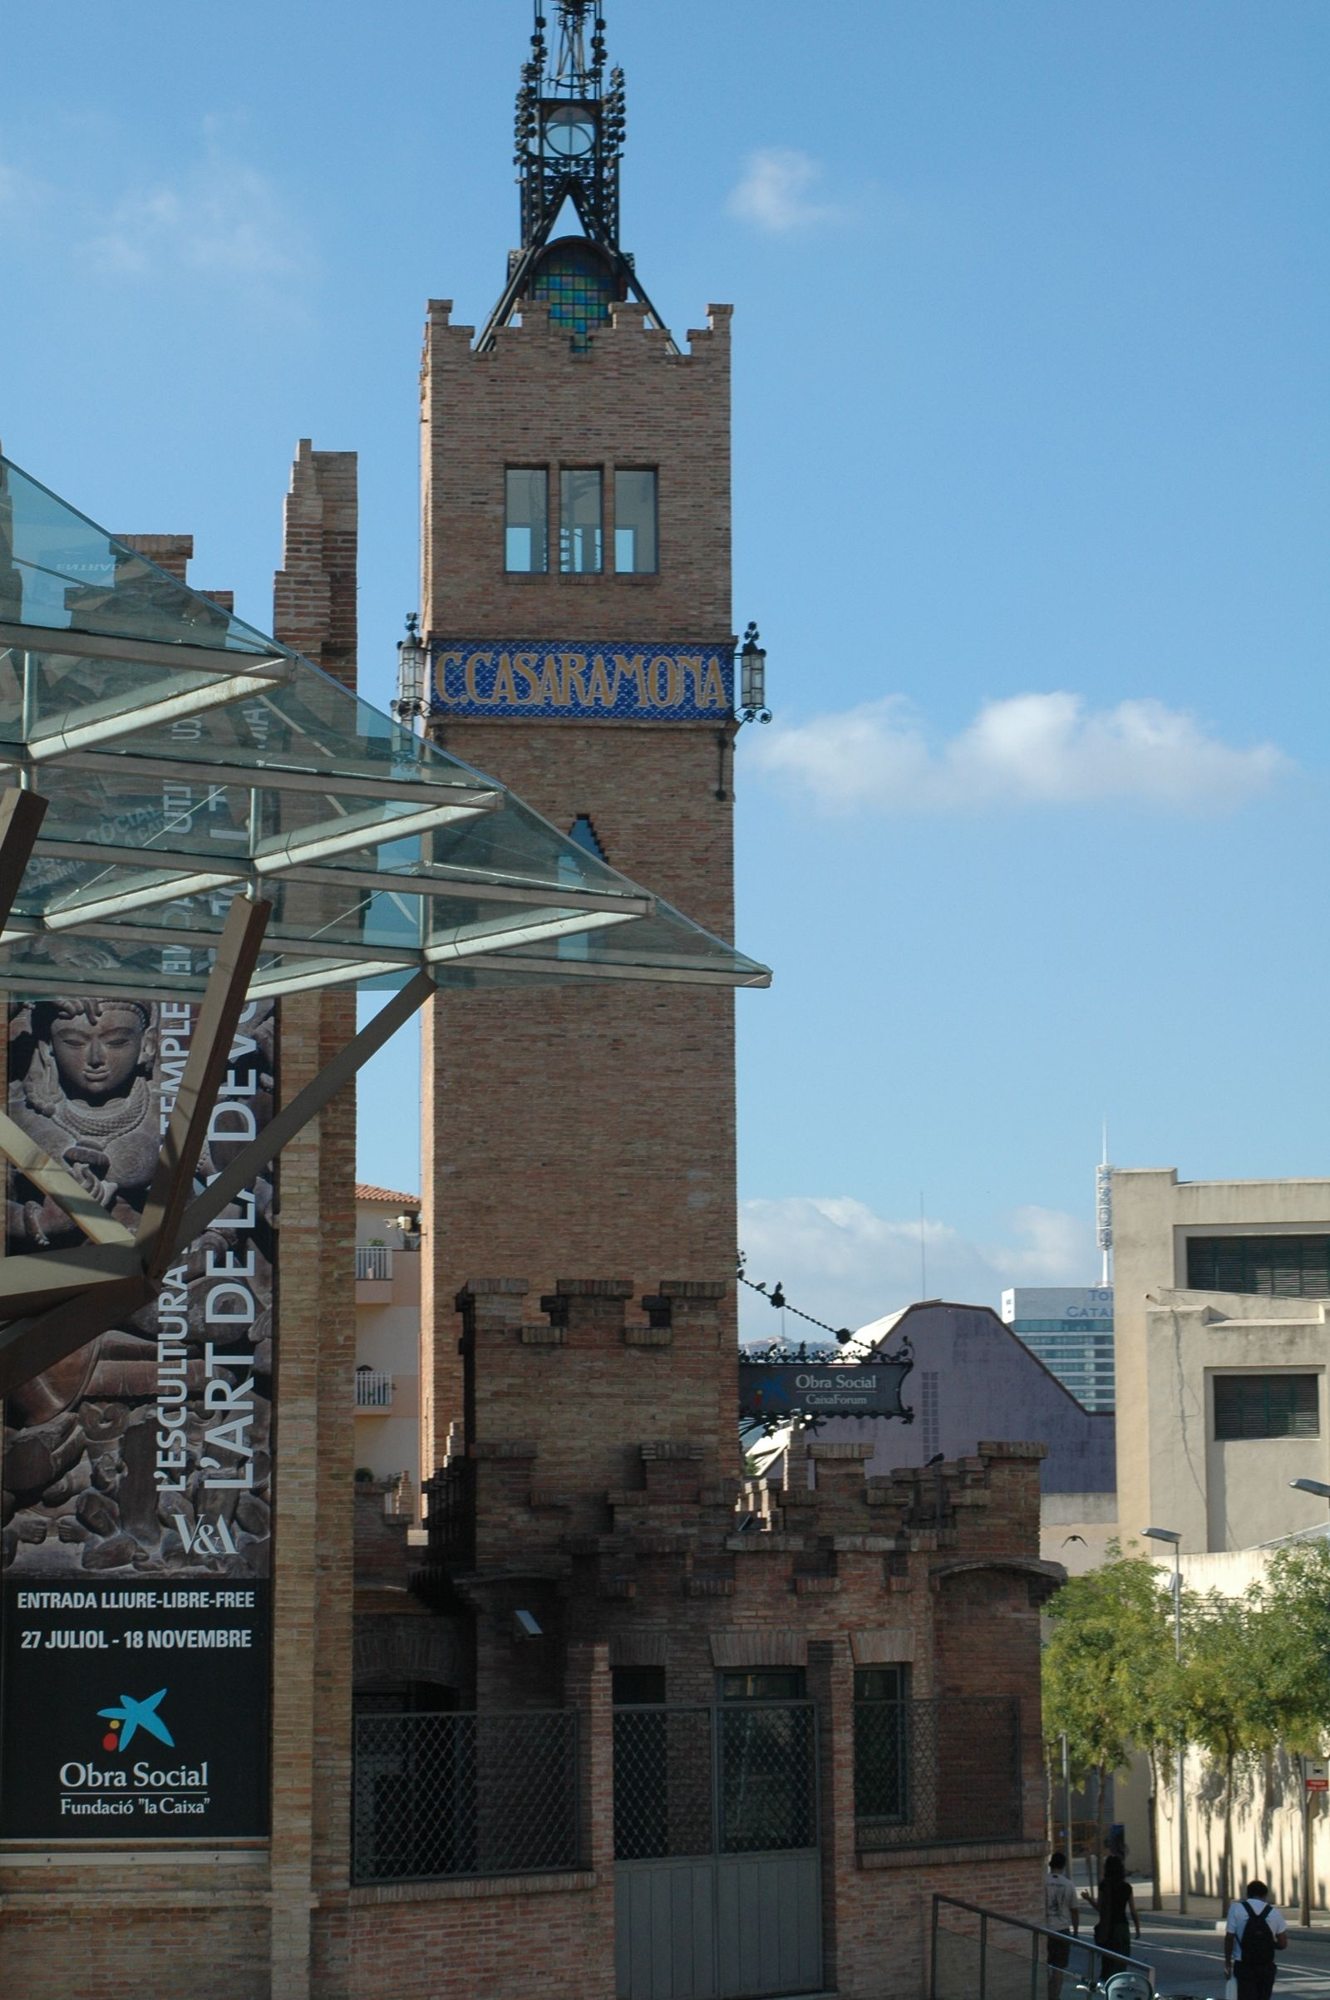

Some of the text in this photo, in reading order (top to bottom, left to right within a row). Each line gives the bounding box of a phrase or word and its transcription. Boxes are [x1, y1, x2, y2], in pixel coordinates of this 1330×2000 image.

[205, 1249, 256, 1324] DE
[154, 1264, 188, 1492] L'ESCULTURA
[795, 1374, 877, 1389] Obra Social
[805, 1393, 868, 1405] CaixaForum
[200, 1341, 255, 1489] L'ART
[171, 1513, 239, 1555] V&A
[17, 1592, 98, 1609] ENTRADA
[21, 1631, 42, 1649] 27
[45, 1630, 109, 1649] JULIOL
[123, 1631, 144, 1649] 18
[147, 1629, 252, 1648] NOVEMBRE
[59, 1761, 209, 1788] Obra Social
[60, 1798, 134, 1815] Fundació
